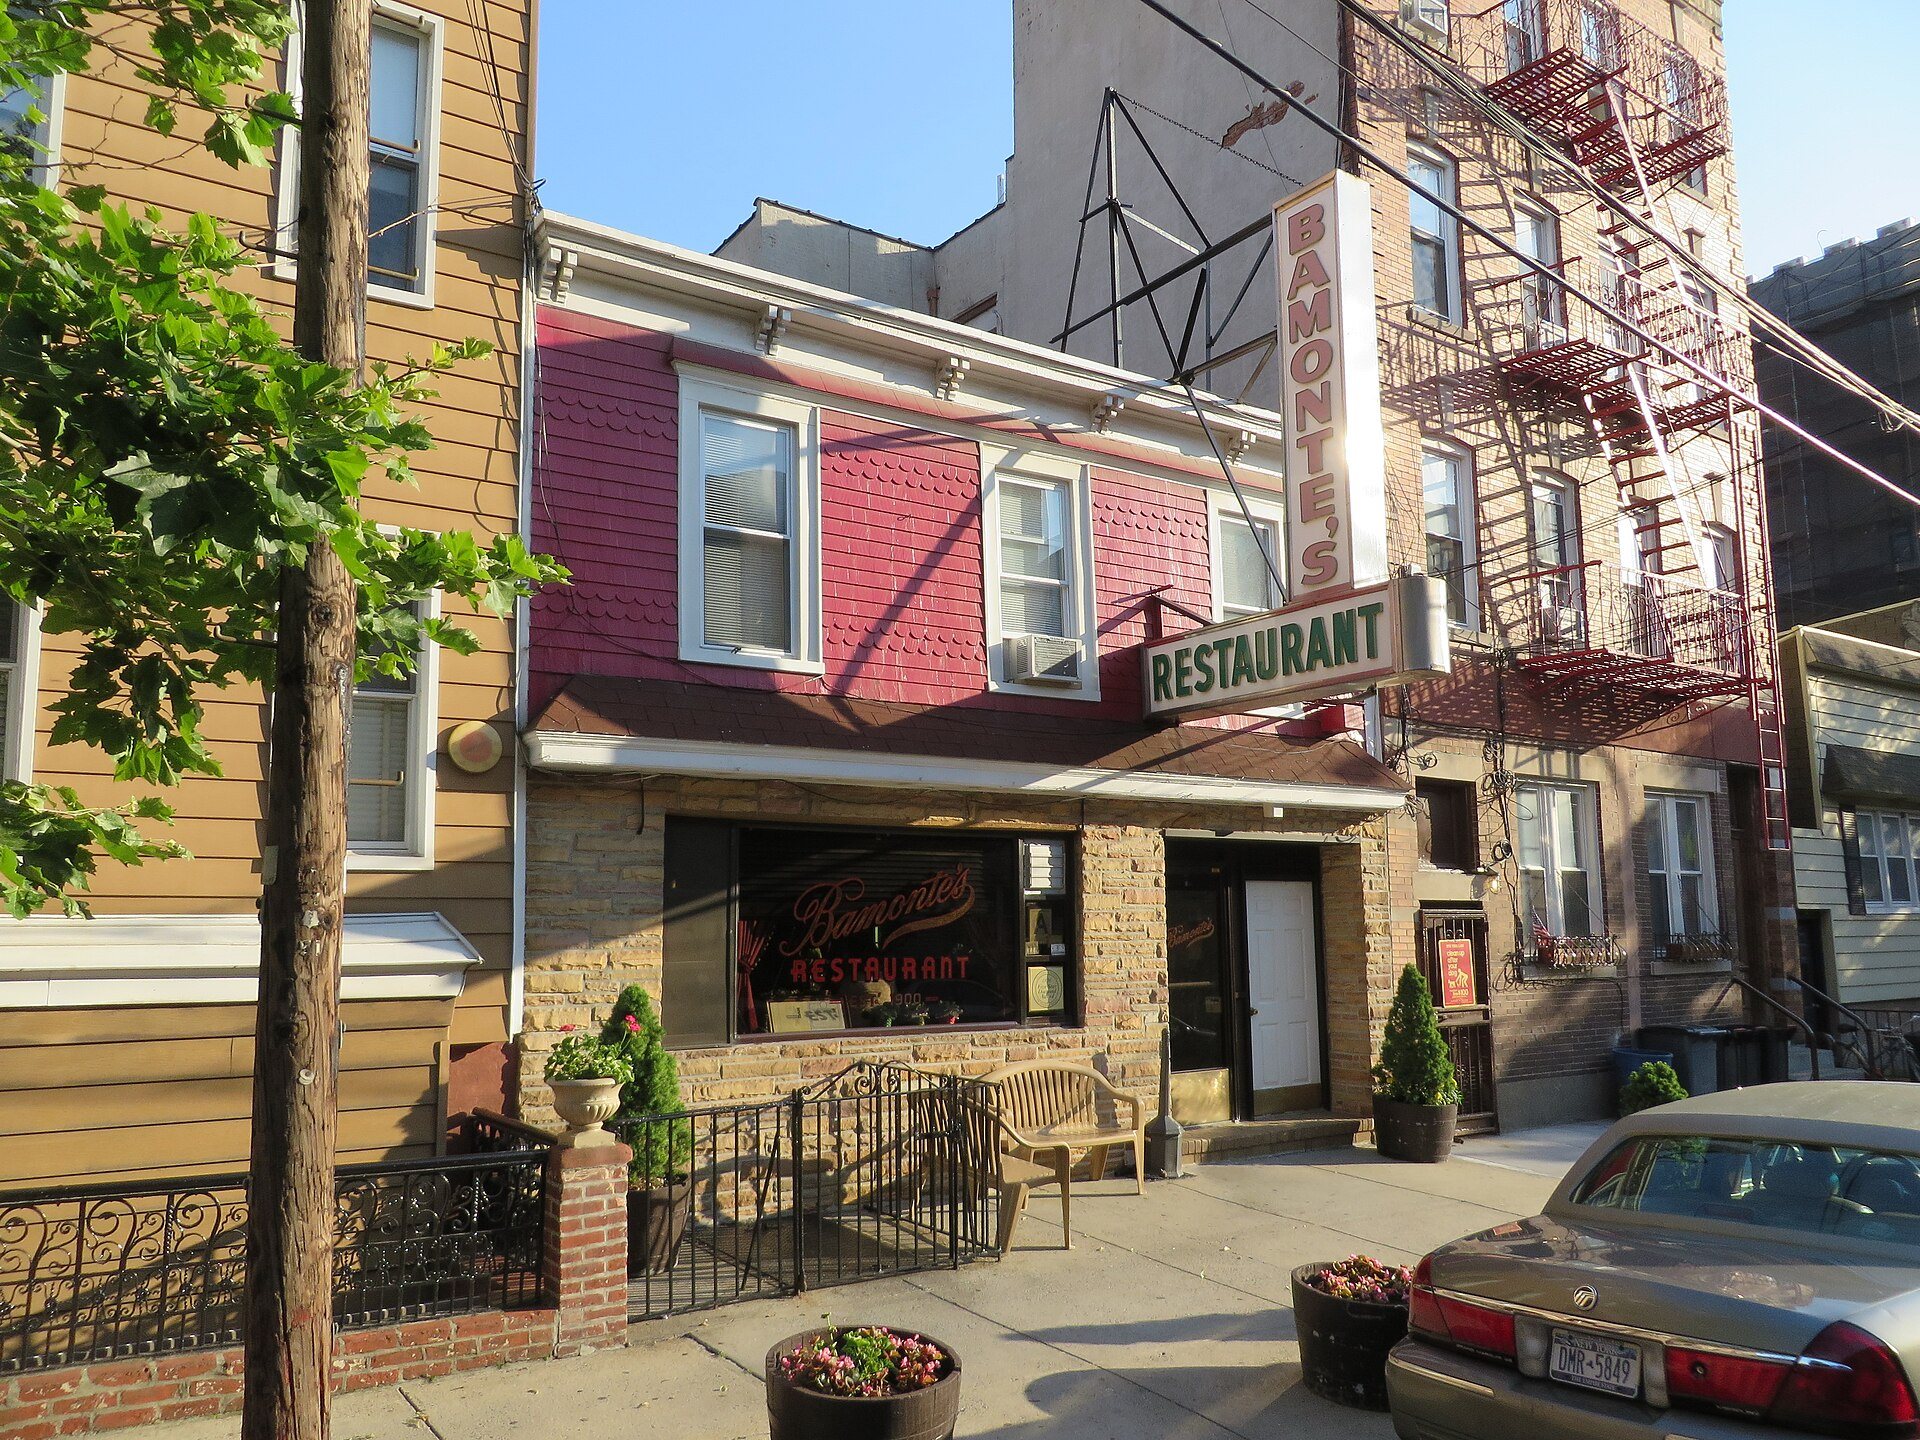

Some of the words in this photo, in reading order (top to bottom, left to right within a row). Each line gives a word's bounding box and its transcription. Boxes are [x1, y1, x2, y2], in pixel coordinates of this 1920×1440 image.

[1288, 203, 1338, 587] BAMONTE'S
[1152, 601, 1385, 701] RESTAURANT
[779, 863, 975, 956] Bamonte's
[790, 956, 969, 983] RESTAURANT
